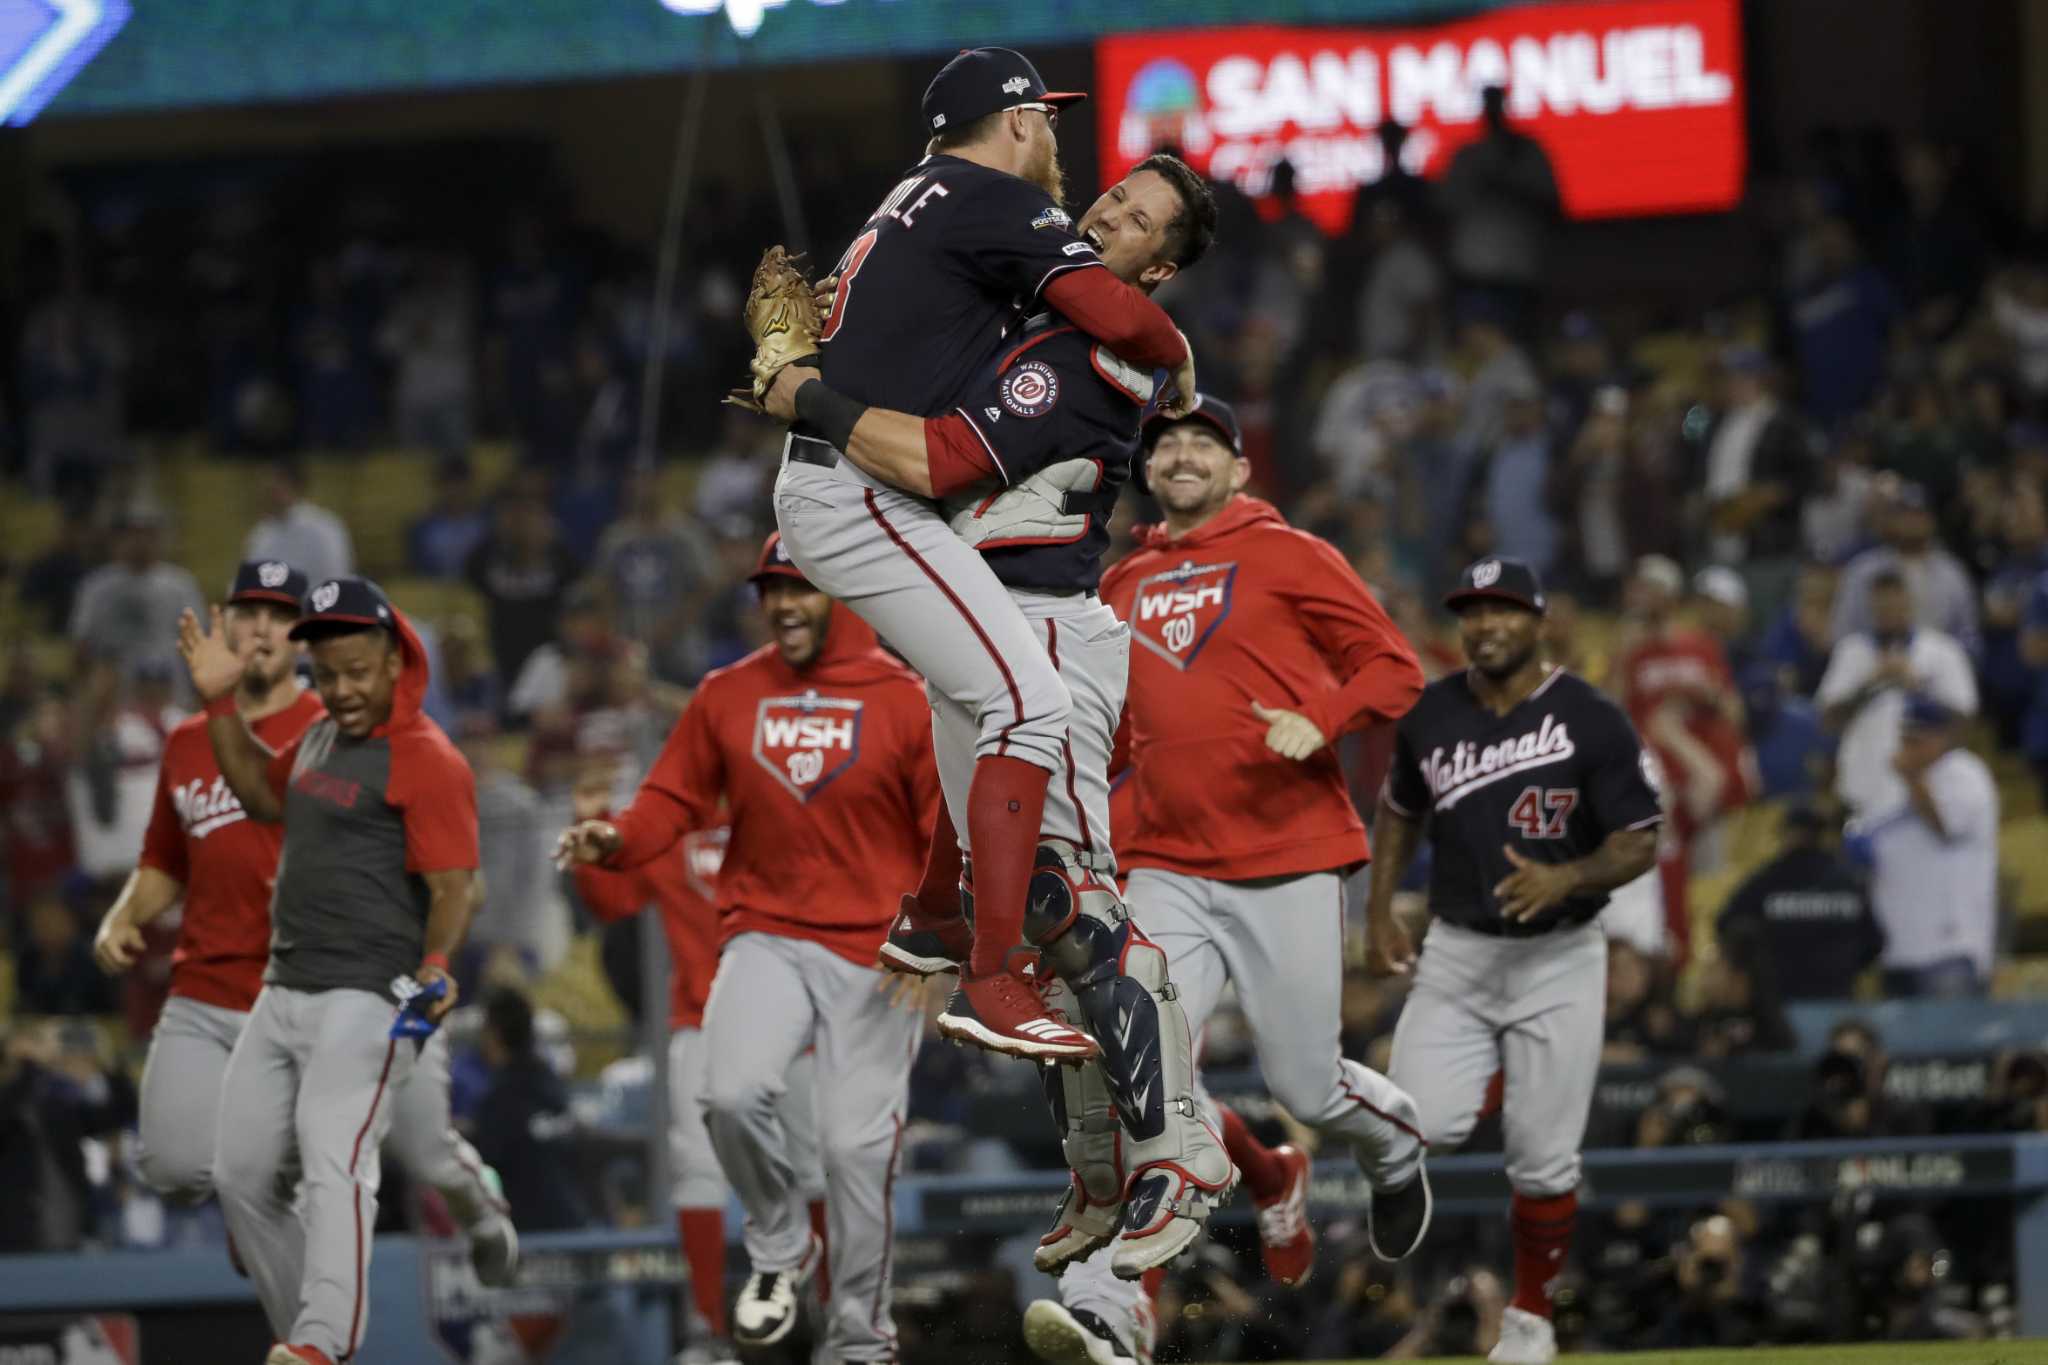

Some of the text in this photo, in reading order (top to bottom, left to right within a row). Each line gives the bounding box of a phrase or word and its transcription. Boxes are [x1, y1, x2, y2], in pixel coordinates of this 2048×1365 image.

[1206, 25, 1733, 137] SAN MANUEL
[1002, 379, 1035, 415] NATIONALS
[1141, 579, 1224, 621] WSH
[763, 717, 855, 750] WSH
[1420, 713, 1575, 812] Nationals
[1508, 786, 1580, 839] 47
